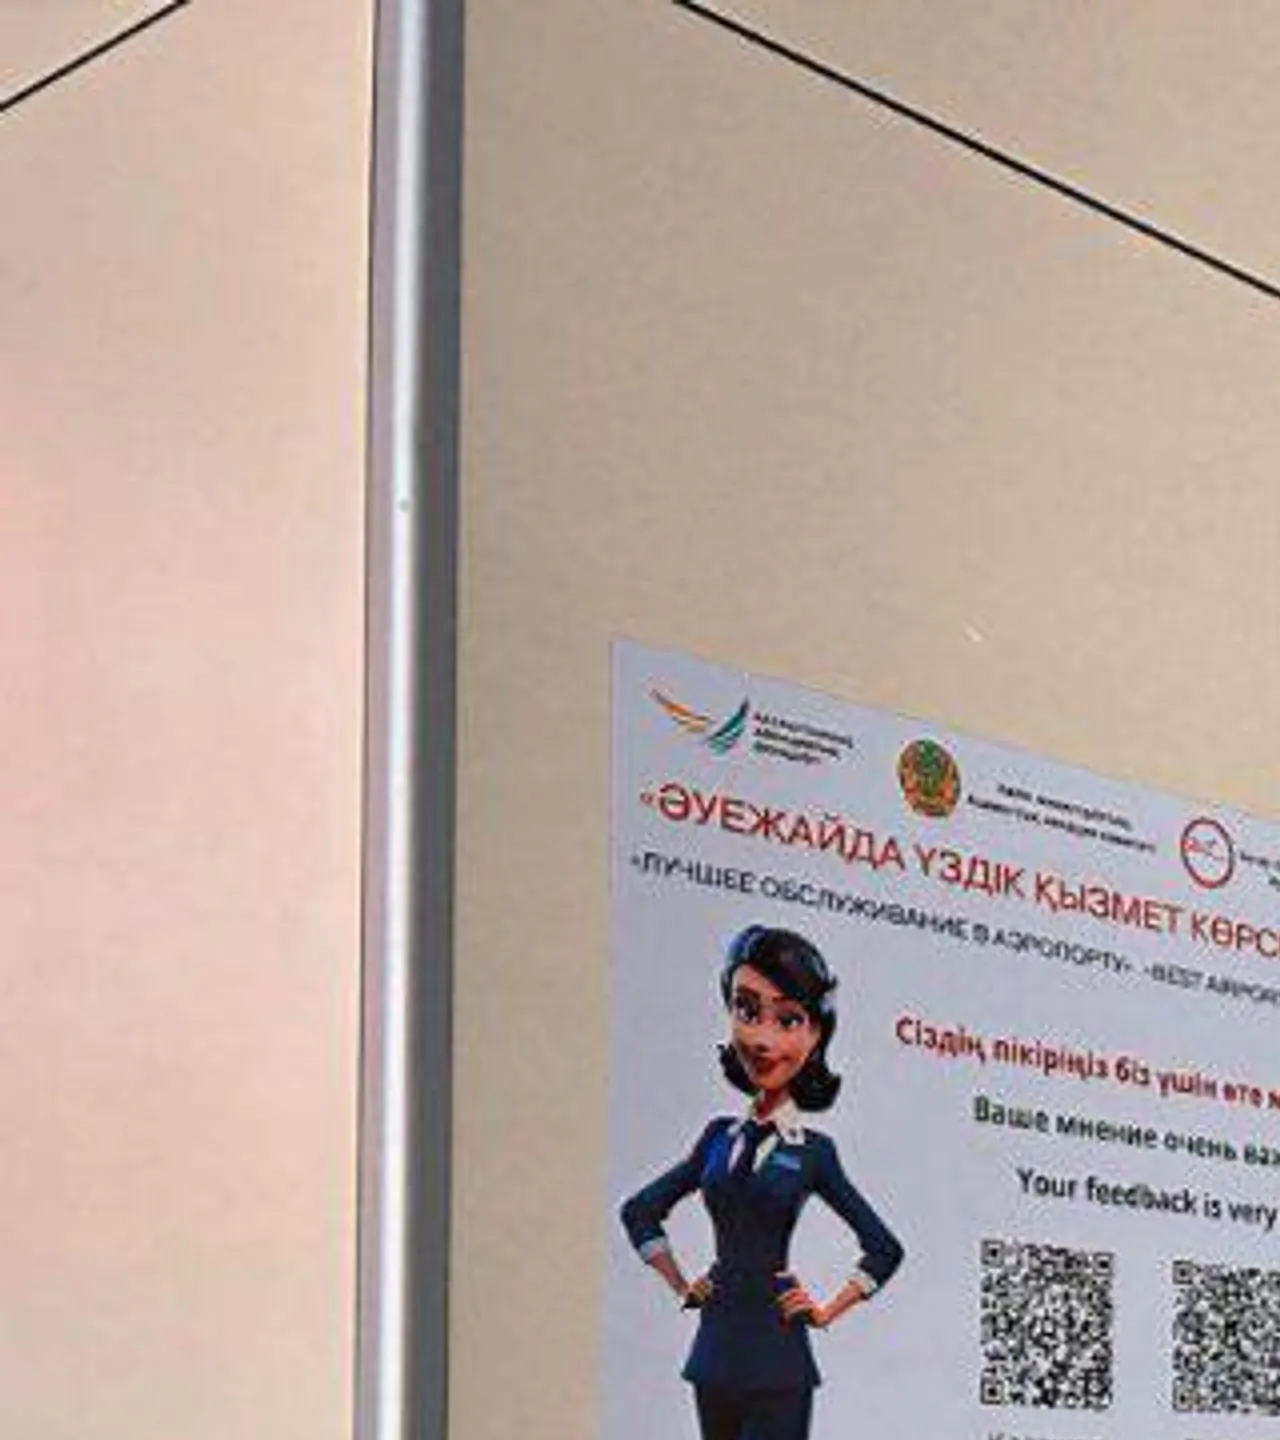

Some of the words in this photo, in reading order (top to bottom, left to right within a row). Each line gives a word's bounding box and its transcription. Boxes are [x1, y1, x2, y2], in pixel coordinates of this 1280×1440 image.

[629, 851, 755, 894] «ЛУЧШЕЕ
[759, 877, 968, 942] ОБСЛУЖИВАНИЕ
[971, 922, 989, 946] В
[639, 782, 906, 871] «ӘУЕЖАЙДА
[914, 843, 1026, 898] ҮЗДІК
[1034, 872, 1185, 935] ҚЫЗМЕТ
[894, 1016, 986, 1063] Сіздің
[992, 1039, 1109, 1081] пікіріңіз
[1114, 1055, 1150, 1086] біз
[1157, 1069, 1217, 1098] үшін
[1222, 1081, 1262, 1107] өте
[973, 1095, 1050, 1133] Ваше
[1056, 1114, 1158, 1149] мнение
[1163, 1129, 1238, 1162] очень
[1015, 1167, 1078, 1198] Your
[1086, 1175, 1198, 1217] feedback
[1203, 1192, 1222, 1219] is
[1227, 1201, 1277, 1232] very
